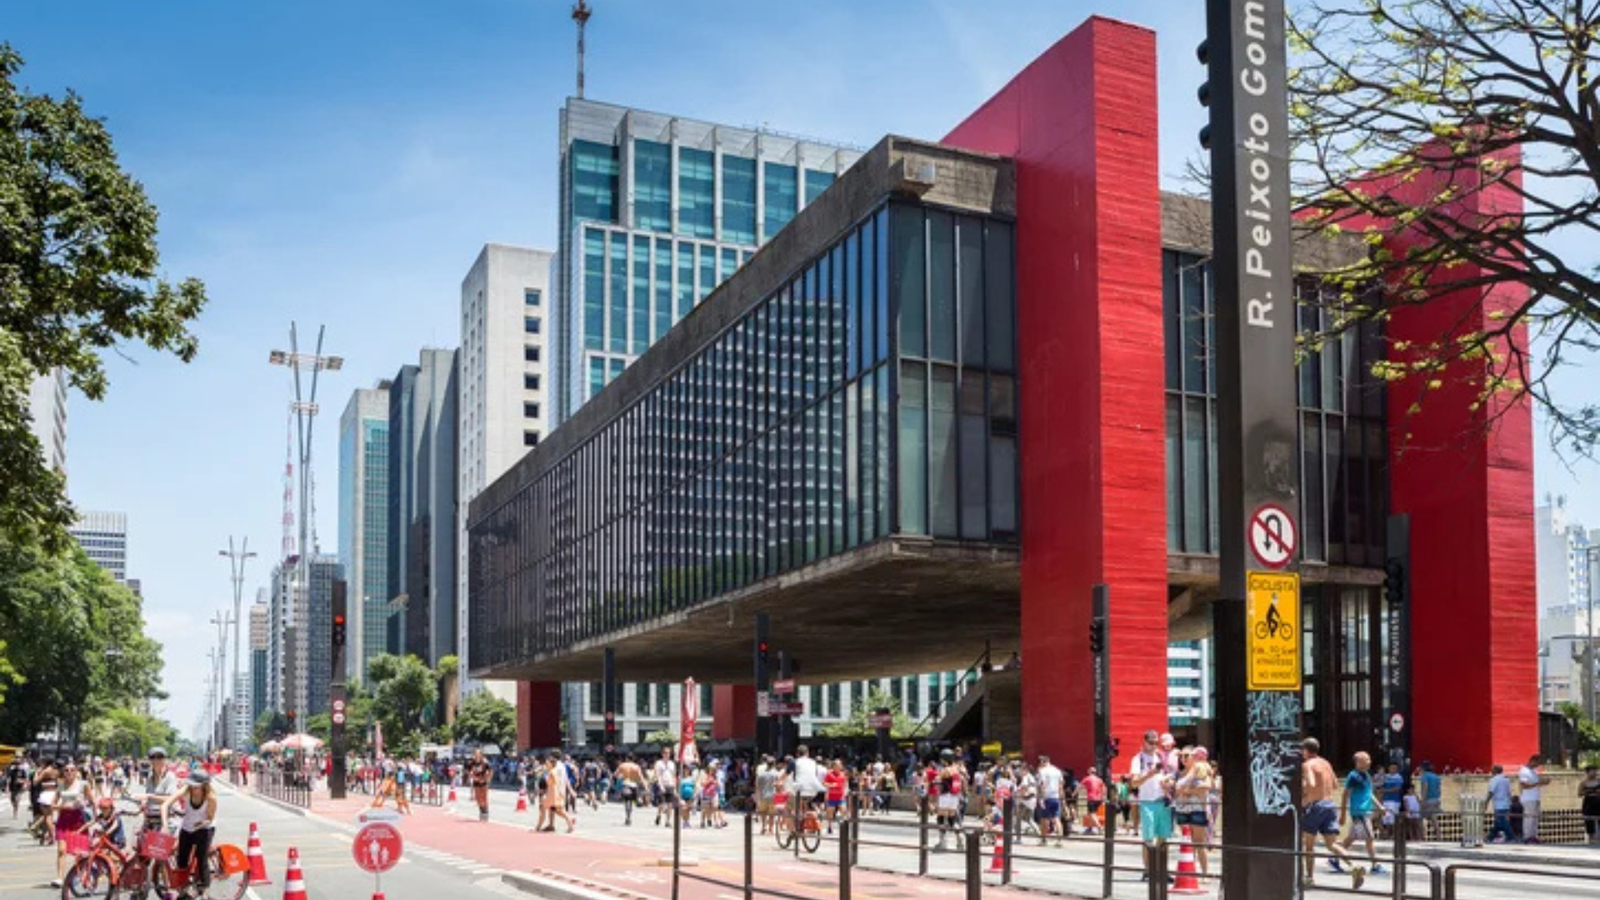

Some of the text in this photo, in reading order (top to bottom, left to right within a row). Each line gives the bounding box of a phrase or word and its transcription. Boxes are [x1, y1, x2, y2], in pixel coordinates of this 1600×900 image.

[1240, 1, 1274, 328] R. Peixoto Gom
[1390, 610, 1400, 665] Paulista
